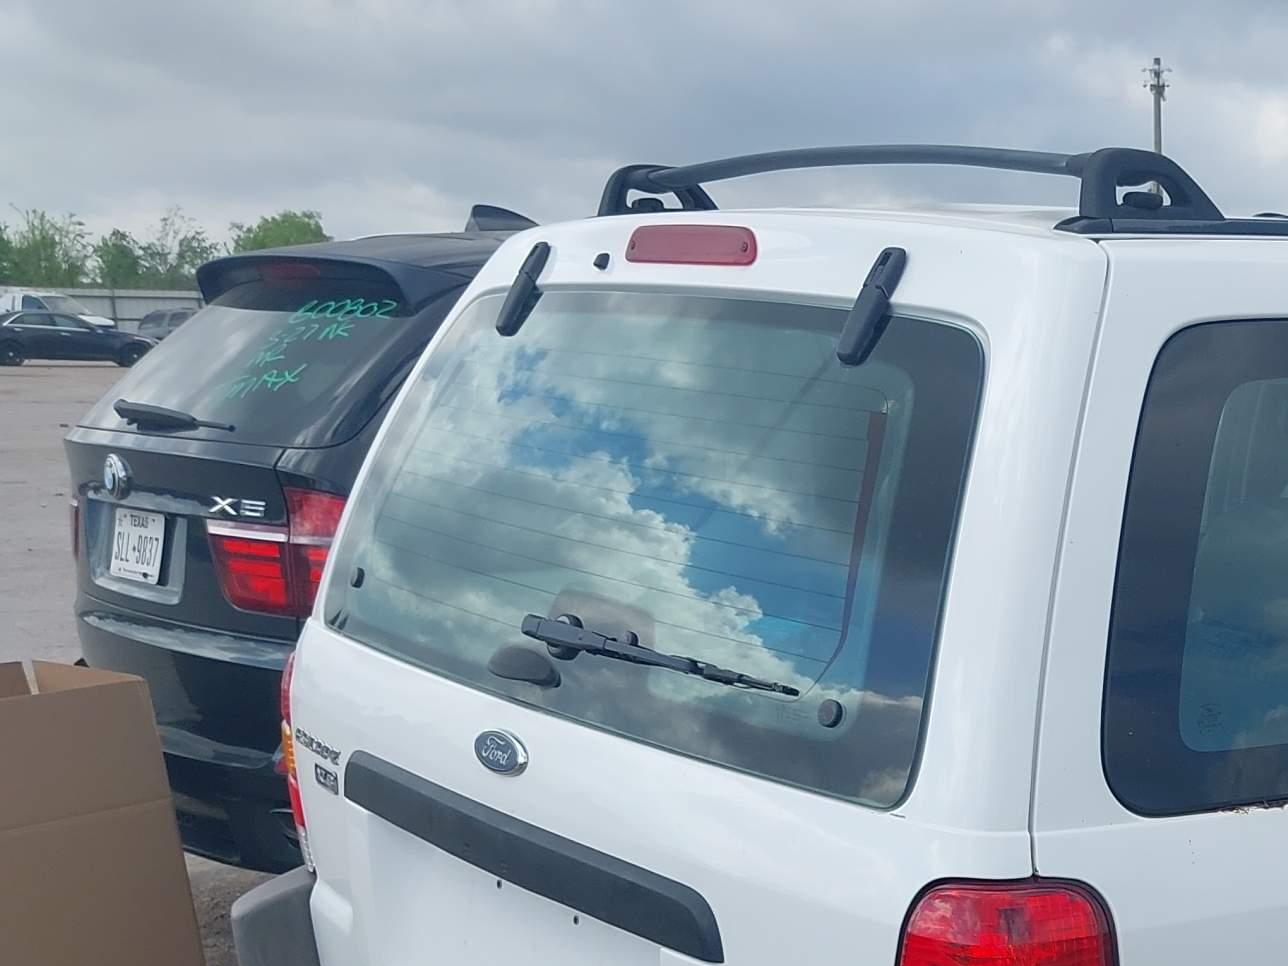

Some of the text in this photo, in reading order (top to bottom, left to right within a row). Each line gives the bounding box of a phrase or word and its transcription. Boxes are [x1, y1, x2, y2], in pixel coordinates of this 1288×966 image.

[209, 496, 267, 517] X5
[130, 514, 149, 529] TEXAS
[482, 736, 511, 765] Ford
